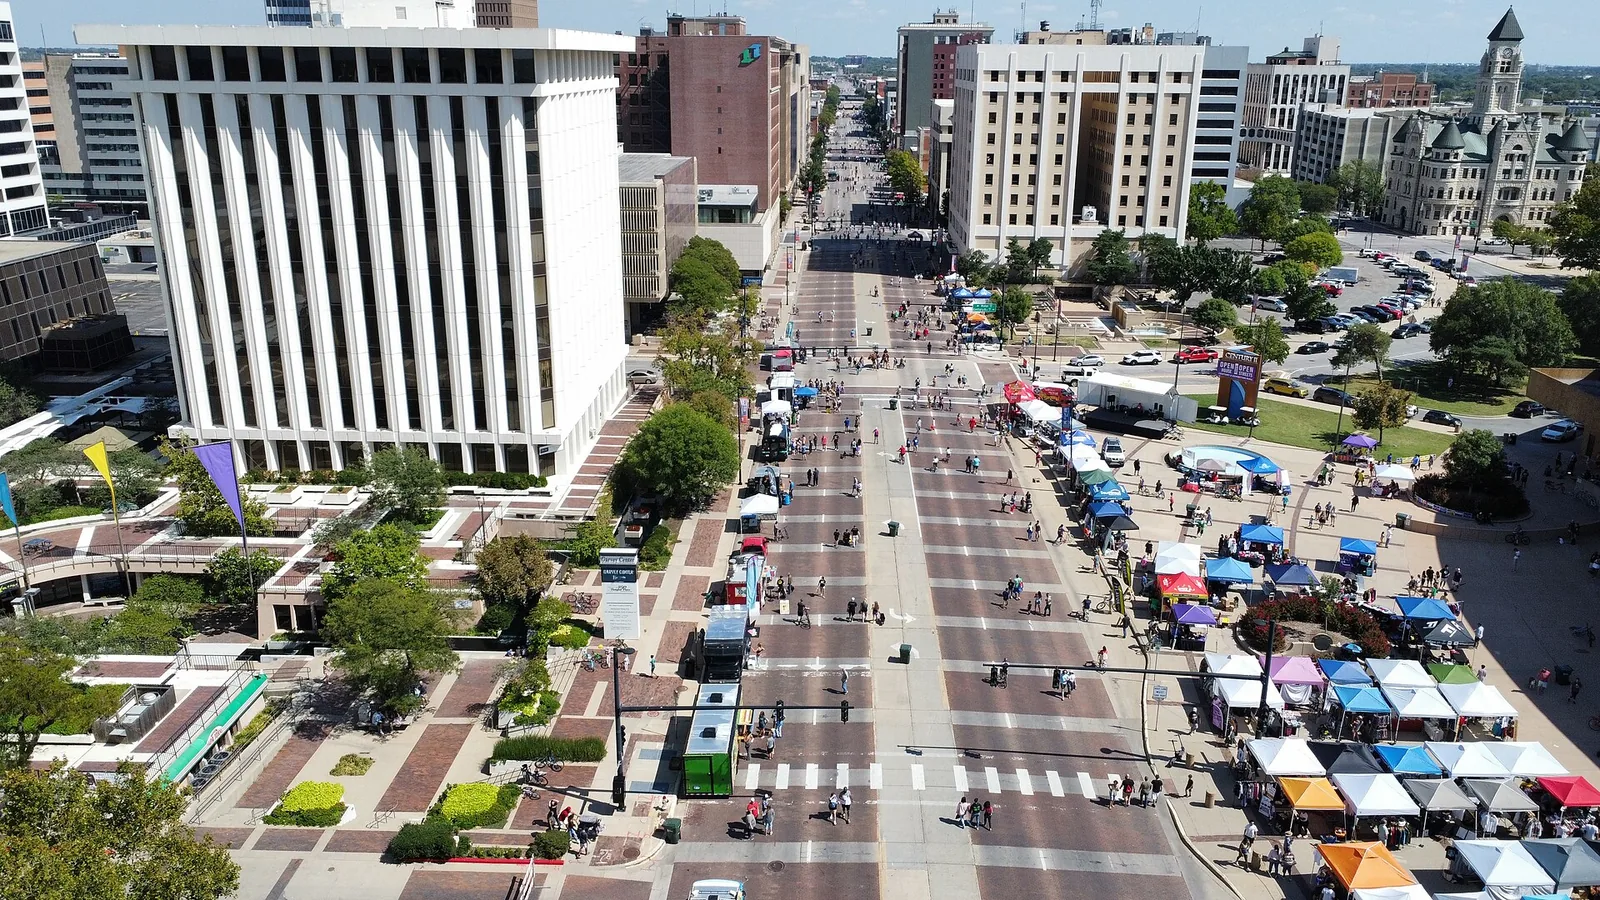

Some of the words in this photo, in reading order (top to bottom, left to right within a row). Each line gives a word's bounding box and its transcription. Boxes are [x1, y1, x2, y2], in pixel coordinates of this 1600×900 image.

[1225, 352, 1253, 362] CENTURY
[1220, 361, 1234, 370] OPEN
[1238, 364, 1254, 373] OPEN
